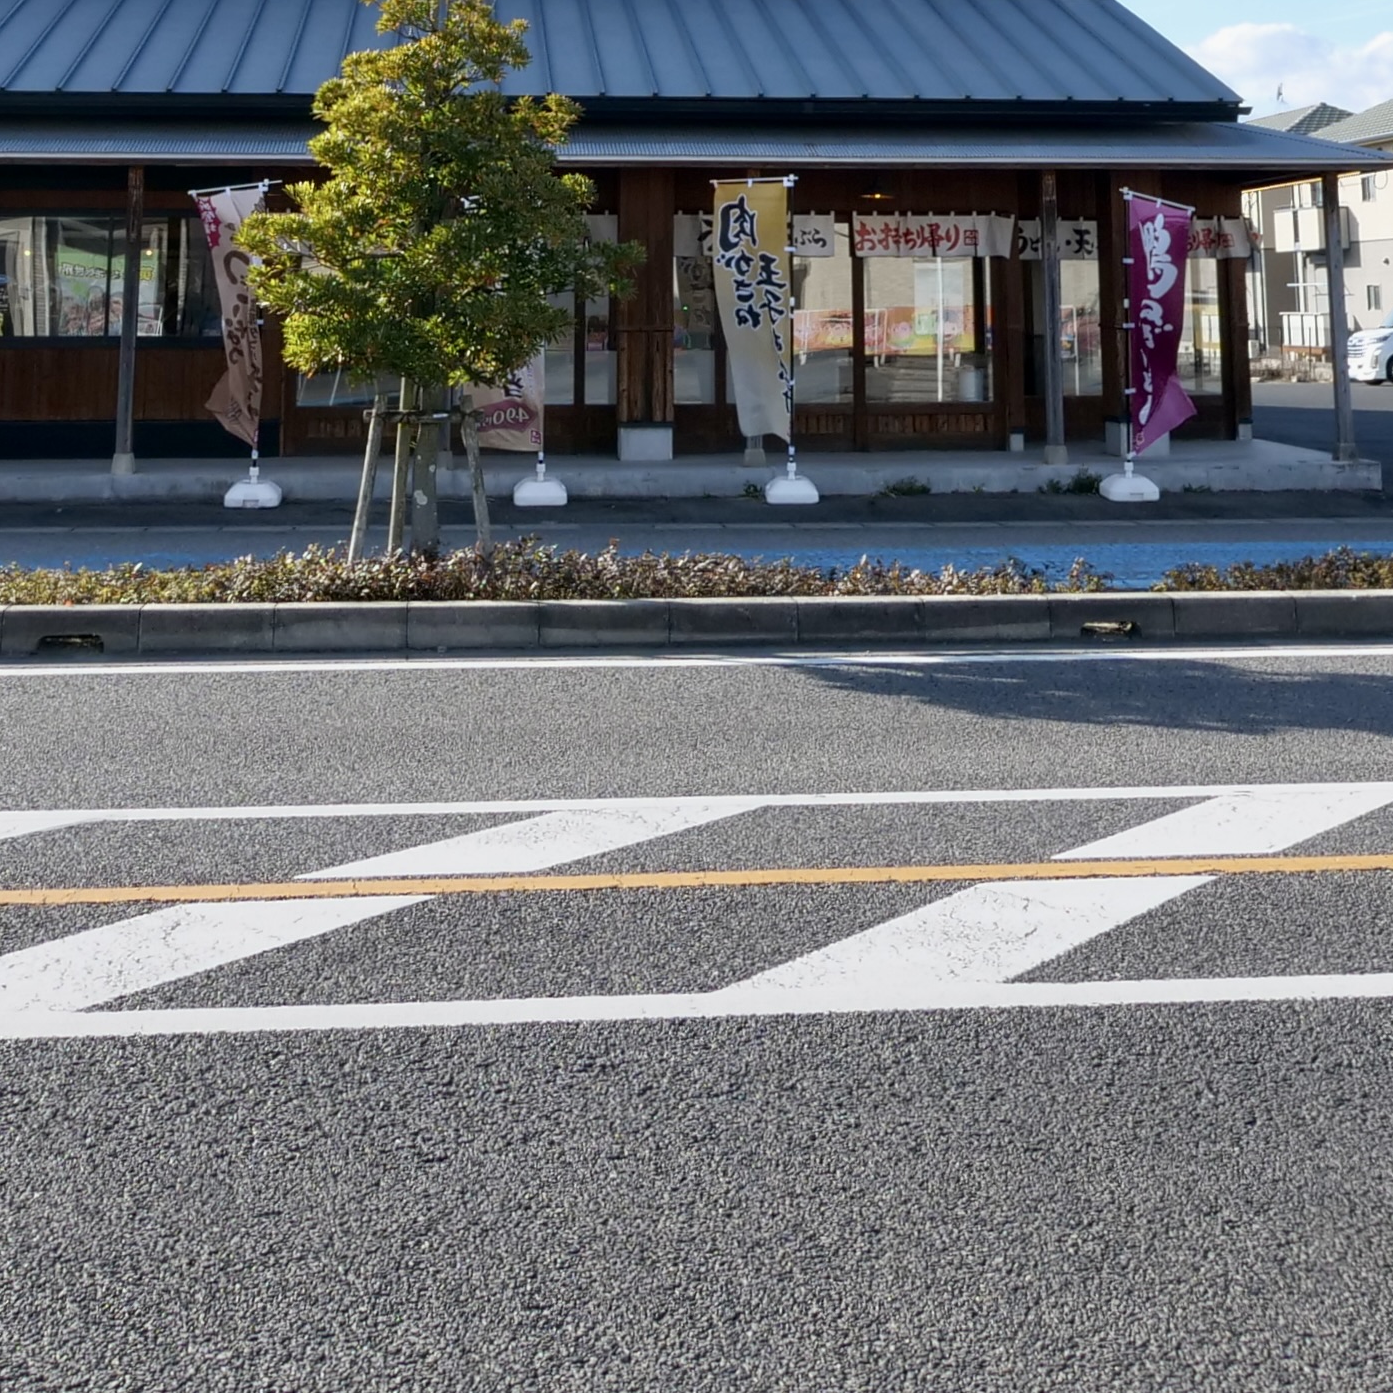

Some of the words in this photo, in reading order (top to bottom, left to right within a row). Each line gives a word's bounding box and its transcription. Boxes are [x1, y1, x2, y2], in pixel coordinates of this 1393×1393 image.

[854, 220, 961, 253] お持ち帰り
